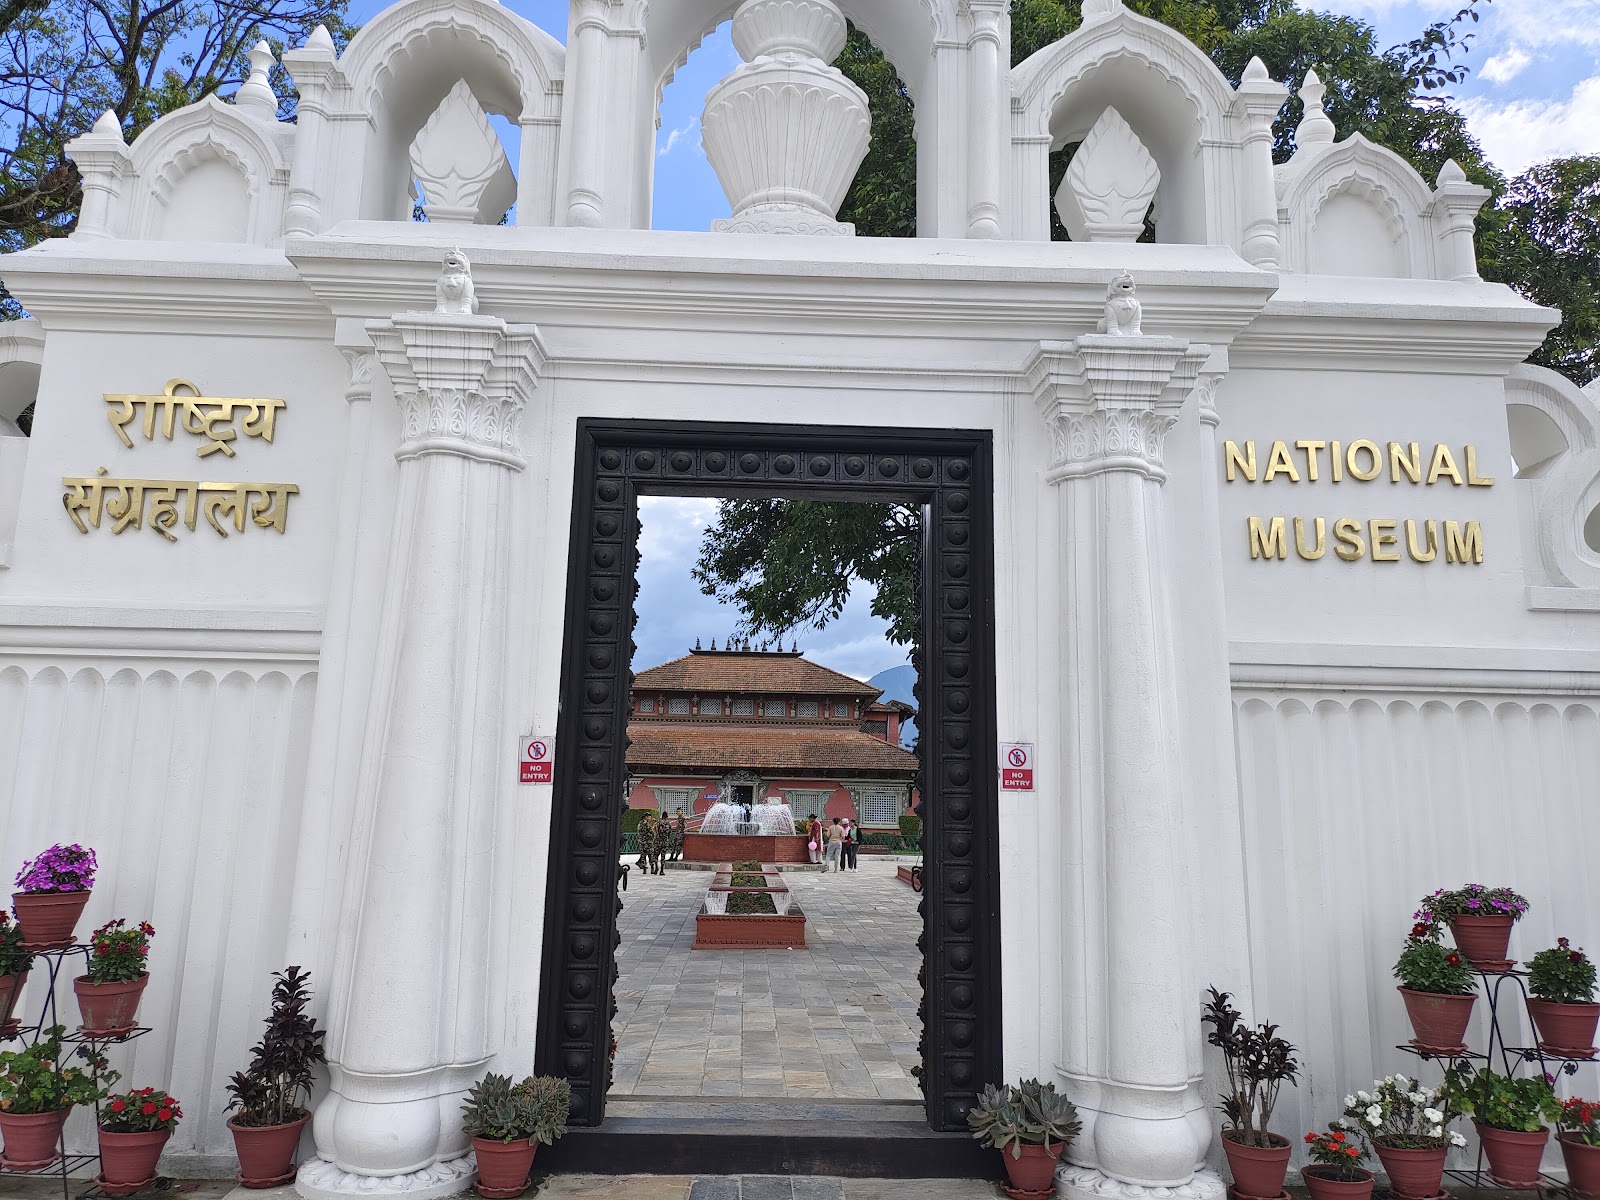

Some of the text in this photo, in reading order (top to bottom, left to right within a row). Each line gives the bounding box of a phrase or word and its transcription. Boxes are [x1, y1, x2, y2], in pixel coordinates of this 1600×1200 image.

[103, 378, 287, 458] राष्ट्रिय
[1224, 438, 1495, 487] NATIONAL
[62, 466, 300, 542] संग्रहालय
[1247, 516, 1484, 564] MUSEUM
